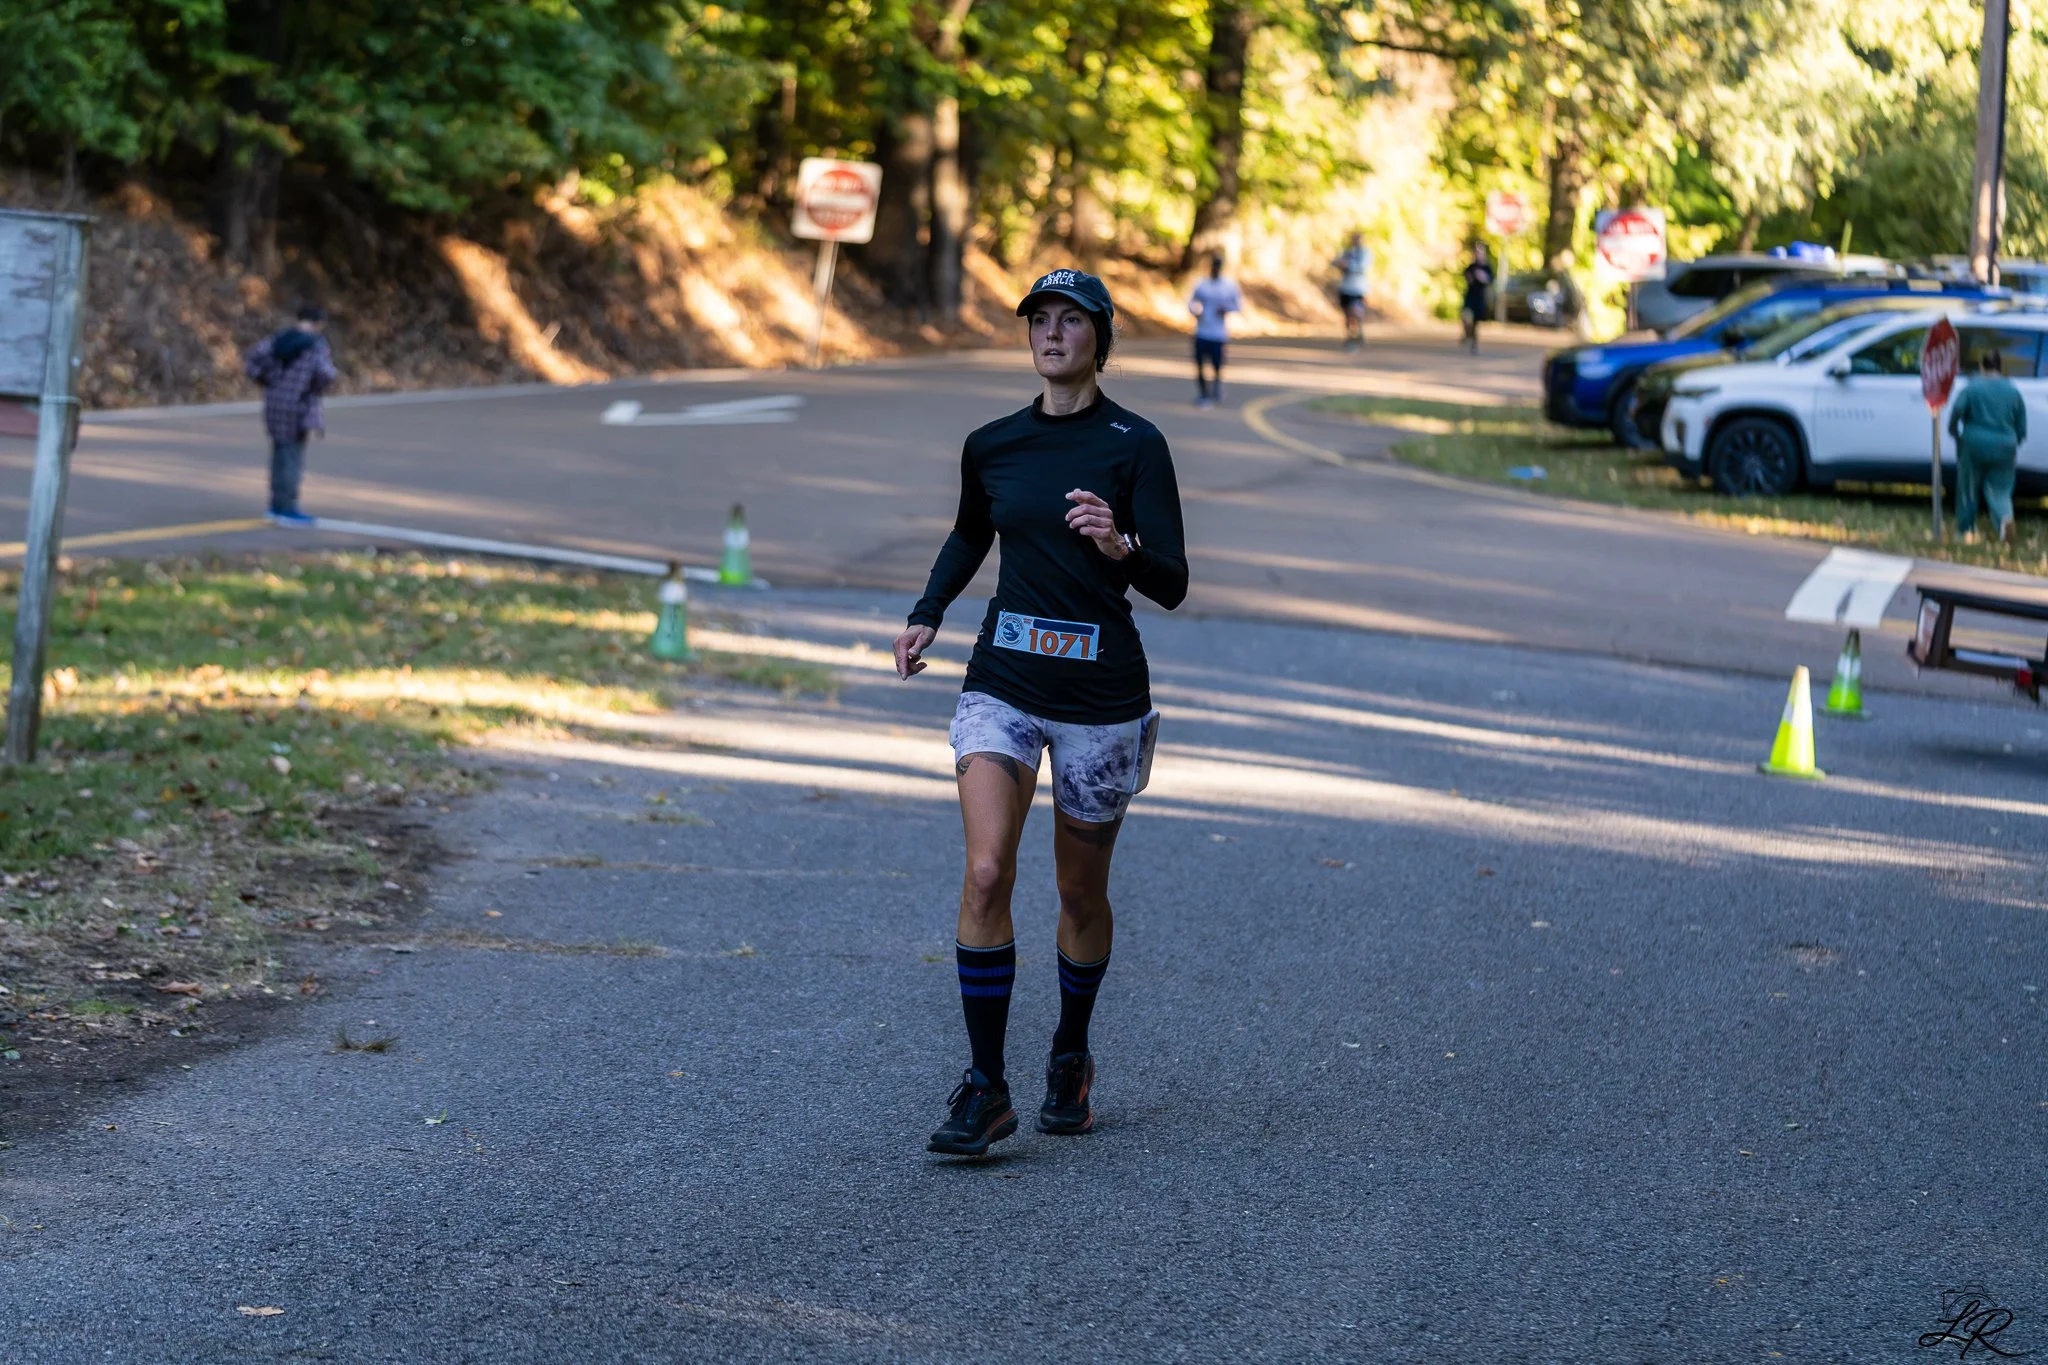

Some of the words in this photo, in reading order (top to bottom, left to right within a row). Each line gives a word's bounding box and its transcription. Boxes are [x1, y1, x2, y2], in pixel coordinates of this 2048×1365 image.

[1047, 271, 1076, 281] BLACK
[1041, 277, 1075, 288] GARLIC
[1029, 628, 1091, 659] 1071
